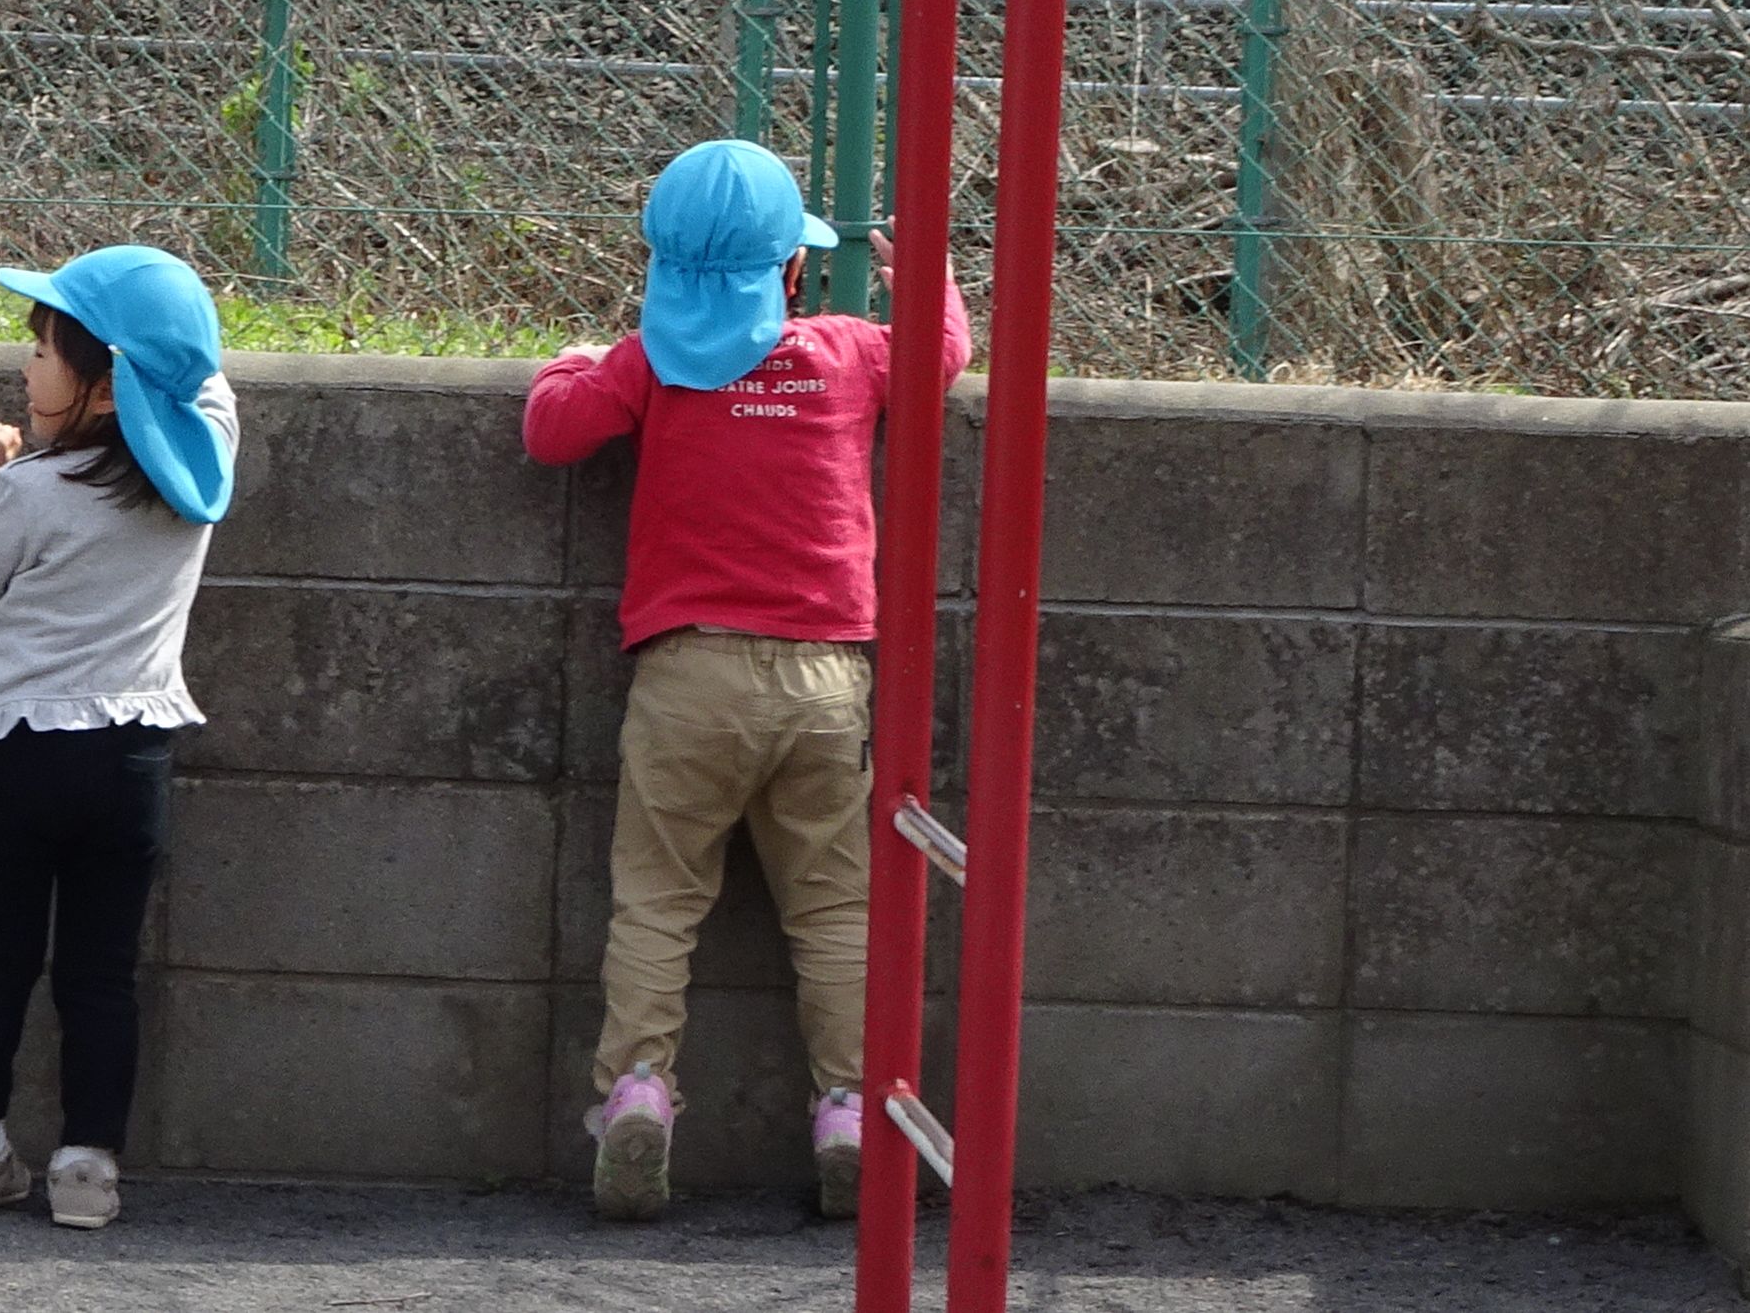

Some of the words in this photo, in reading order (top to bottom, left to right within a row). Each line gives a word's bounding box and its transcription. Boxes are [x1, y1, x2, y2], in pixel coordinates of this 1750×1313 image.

[718, 380, 765, 394] ATRE
[771, 379, 826, 394] JOURS
[730, 404, 797, 417] CHAUDS
